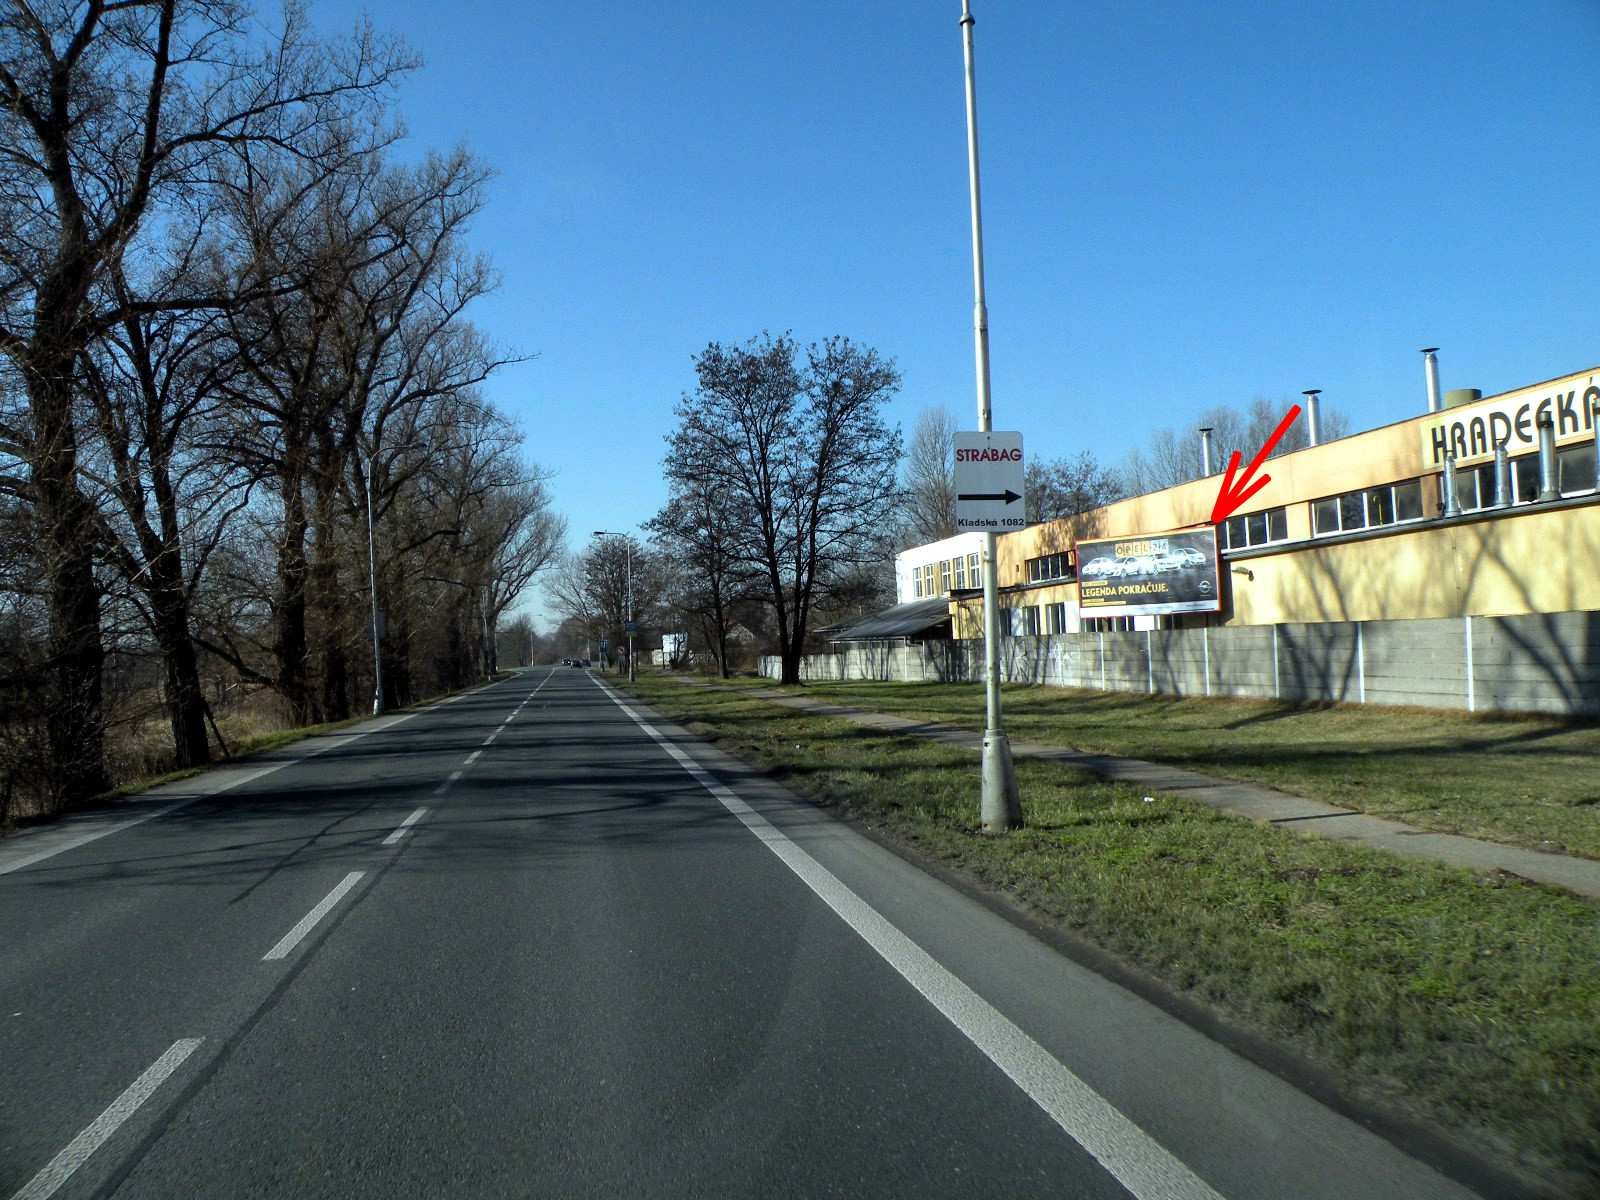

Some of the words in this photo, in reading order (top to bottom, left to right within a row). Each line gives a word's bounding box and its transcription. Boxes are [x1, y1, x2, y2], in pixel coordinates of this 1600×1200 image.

[956, 448, 1022, 462] STRABAG
[1001, 518, 1025, 527] 1082
[1081, 587, 1117, 598] LEGENDA
[1118, 582, 1169, 596] POKRAČUJE.
